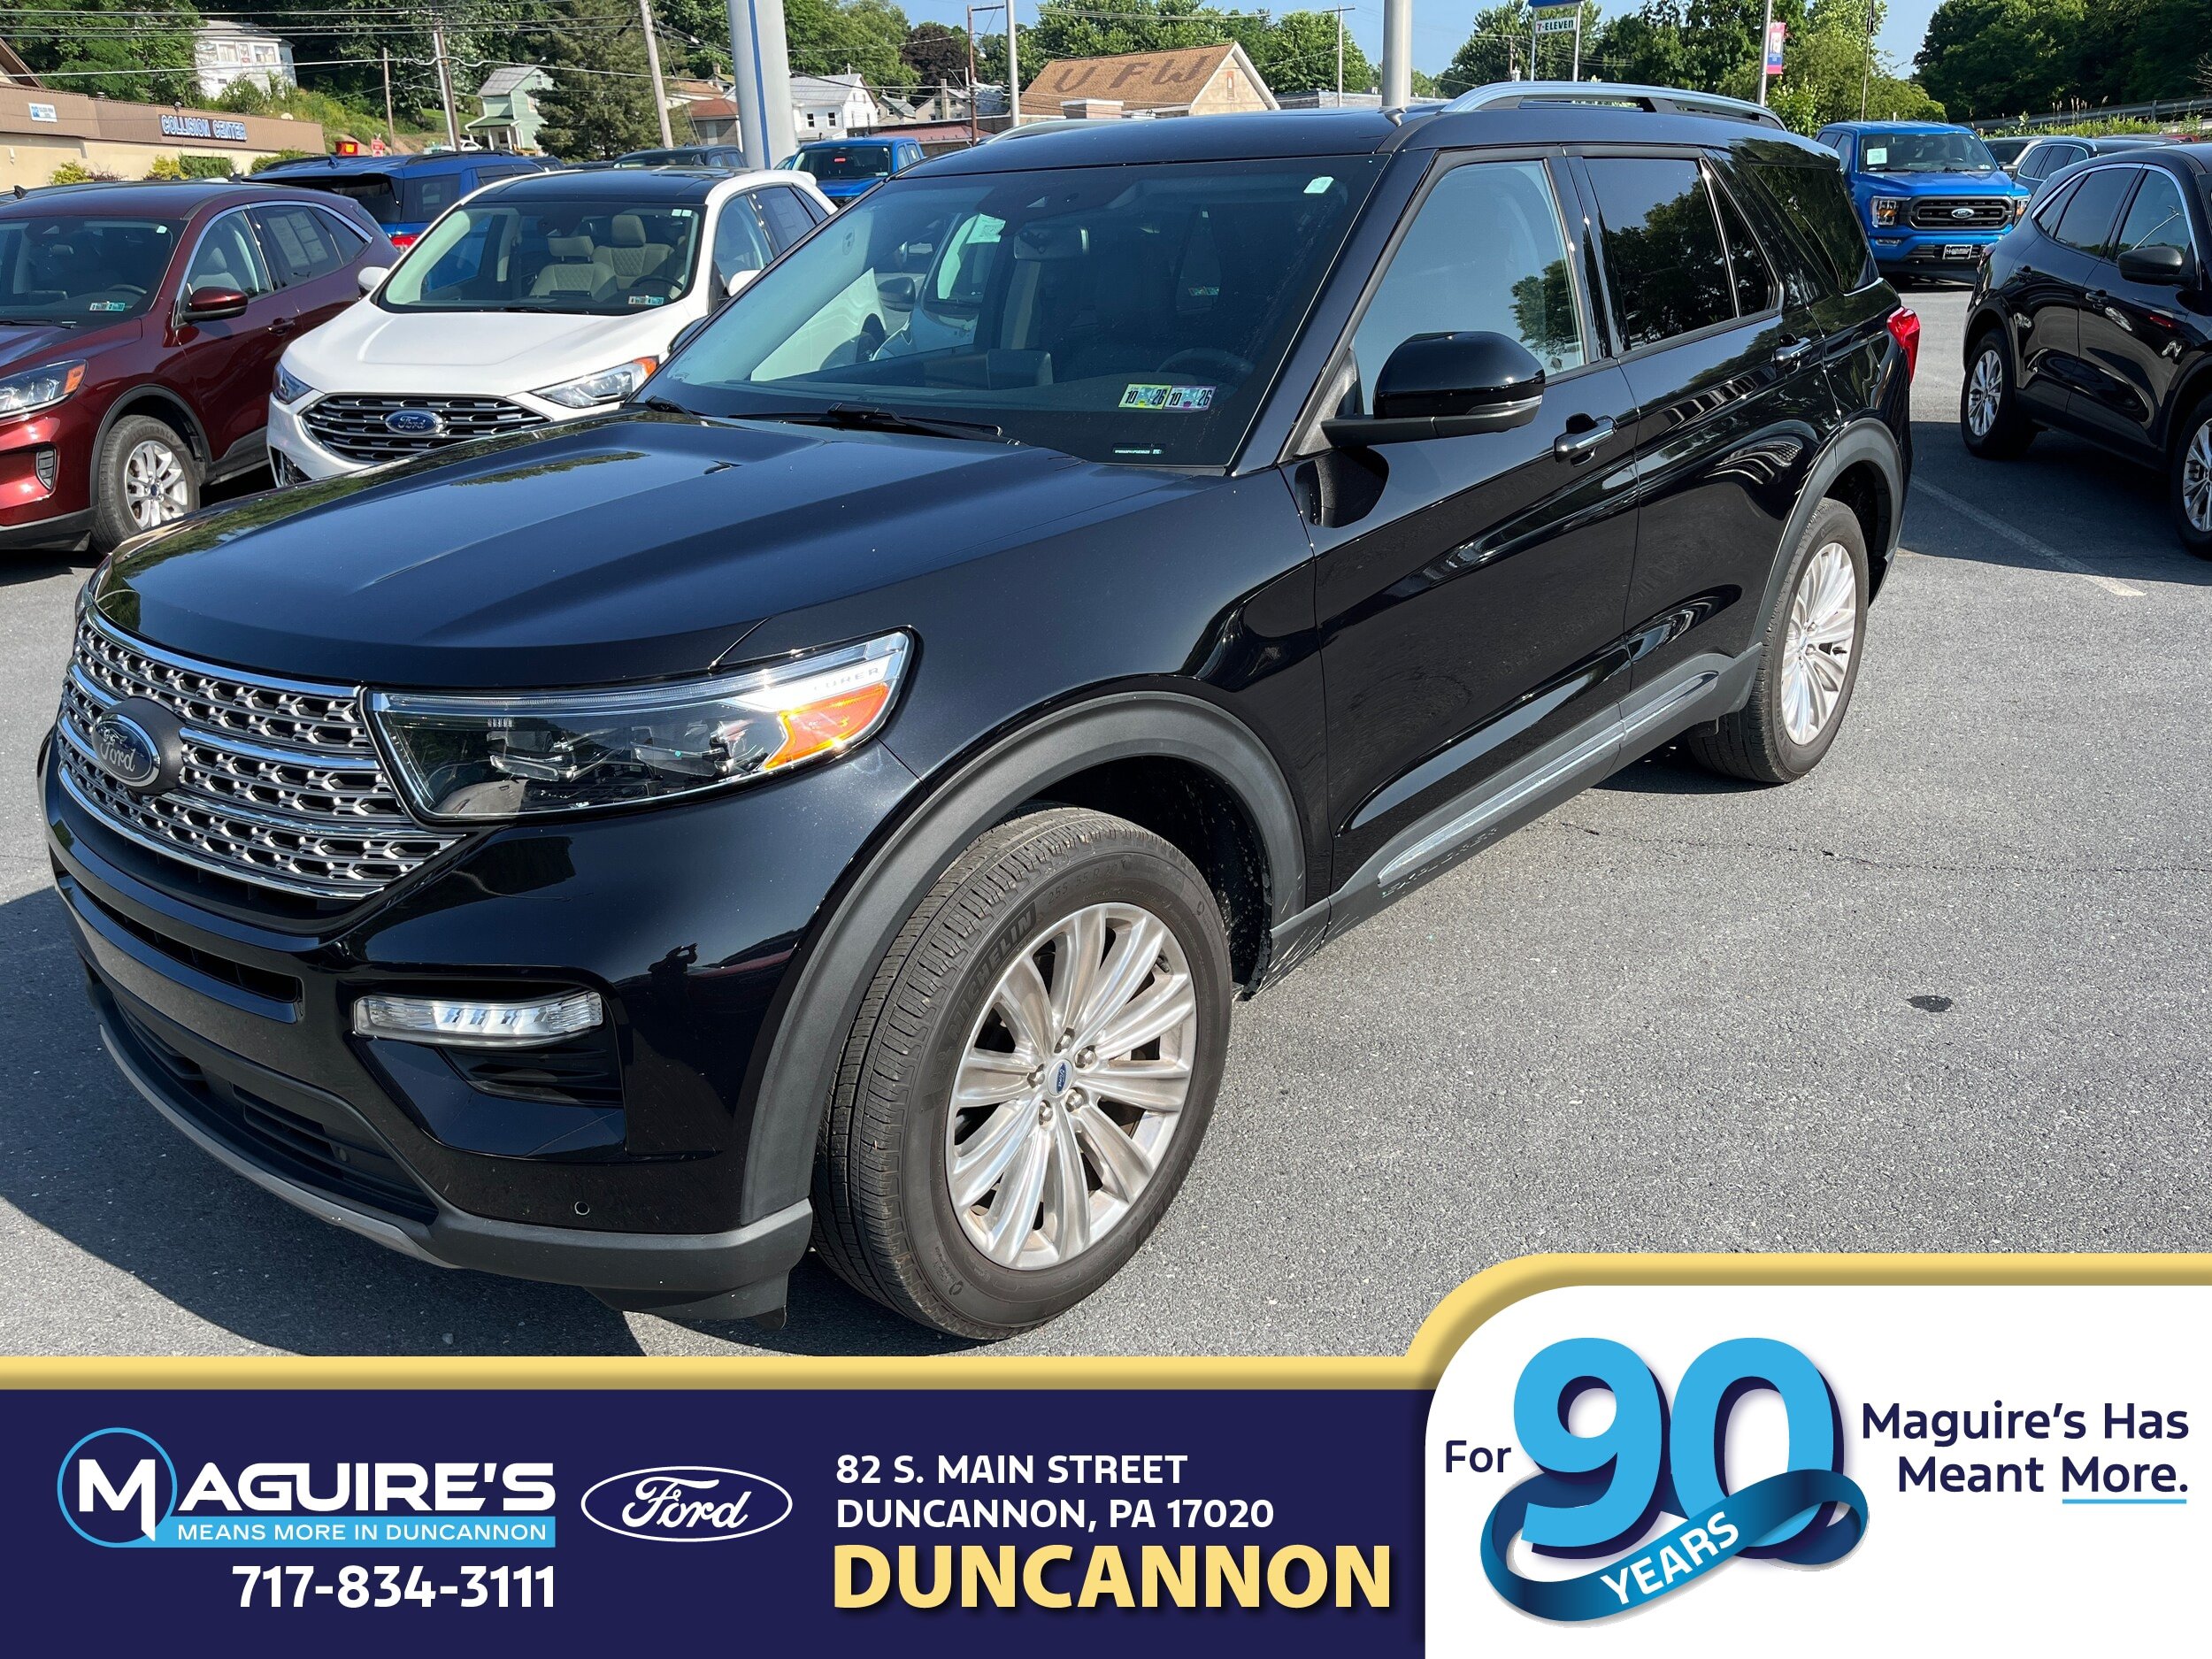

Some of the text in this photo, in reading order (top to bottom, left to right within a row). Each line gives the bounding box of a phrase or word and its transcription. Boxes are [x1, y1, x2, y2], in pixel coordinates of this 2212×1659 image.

[161, 114, 247, 140] COLLISION CENTER
[398, 415, 426, 429] Ford
[100, 726, 137, 772] Ford
[948, 910, 1033, 1042] MICHELIN
